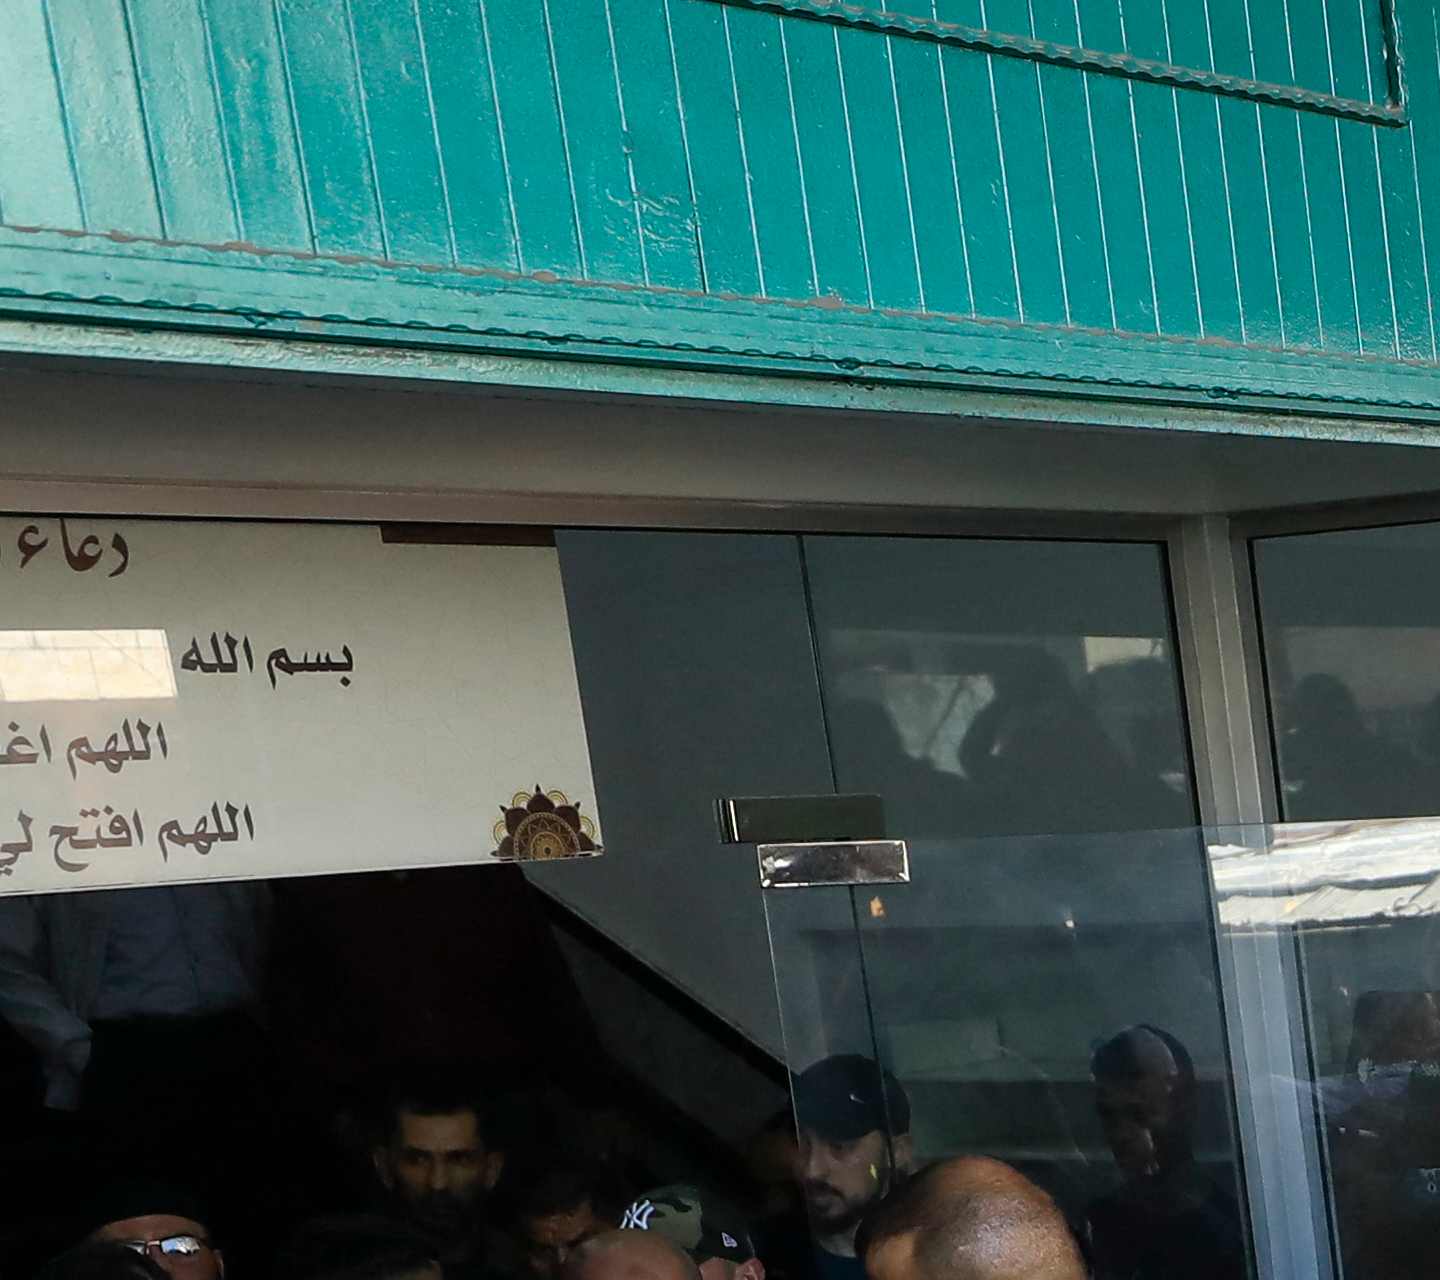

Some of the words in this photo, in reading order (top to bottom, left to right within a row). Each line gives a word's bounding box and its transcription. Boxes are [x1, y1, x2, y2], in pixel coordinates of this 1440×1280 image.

[15, 516, 130, 578] دعاء
[180, 631, 255, 675] الله
[265, 642, 354, 690] بسم
[0, 721, 52, 766] اغ
[66, 718, 168, 781] اللهم
[49, 804, 144, 873] افتح
[158, 801, 255, 862] اللهم
